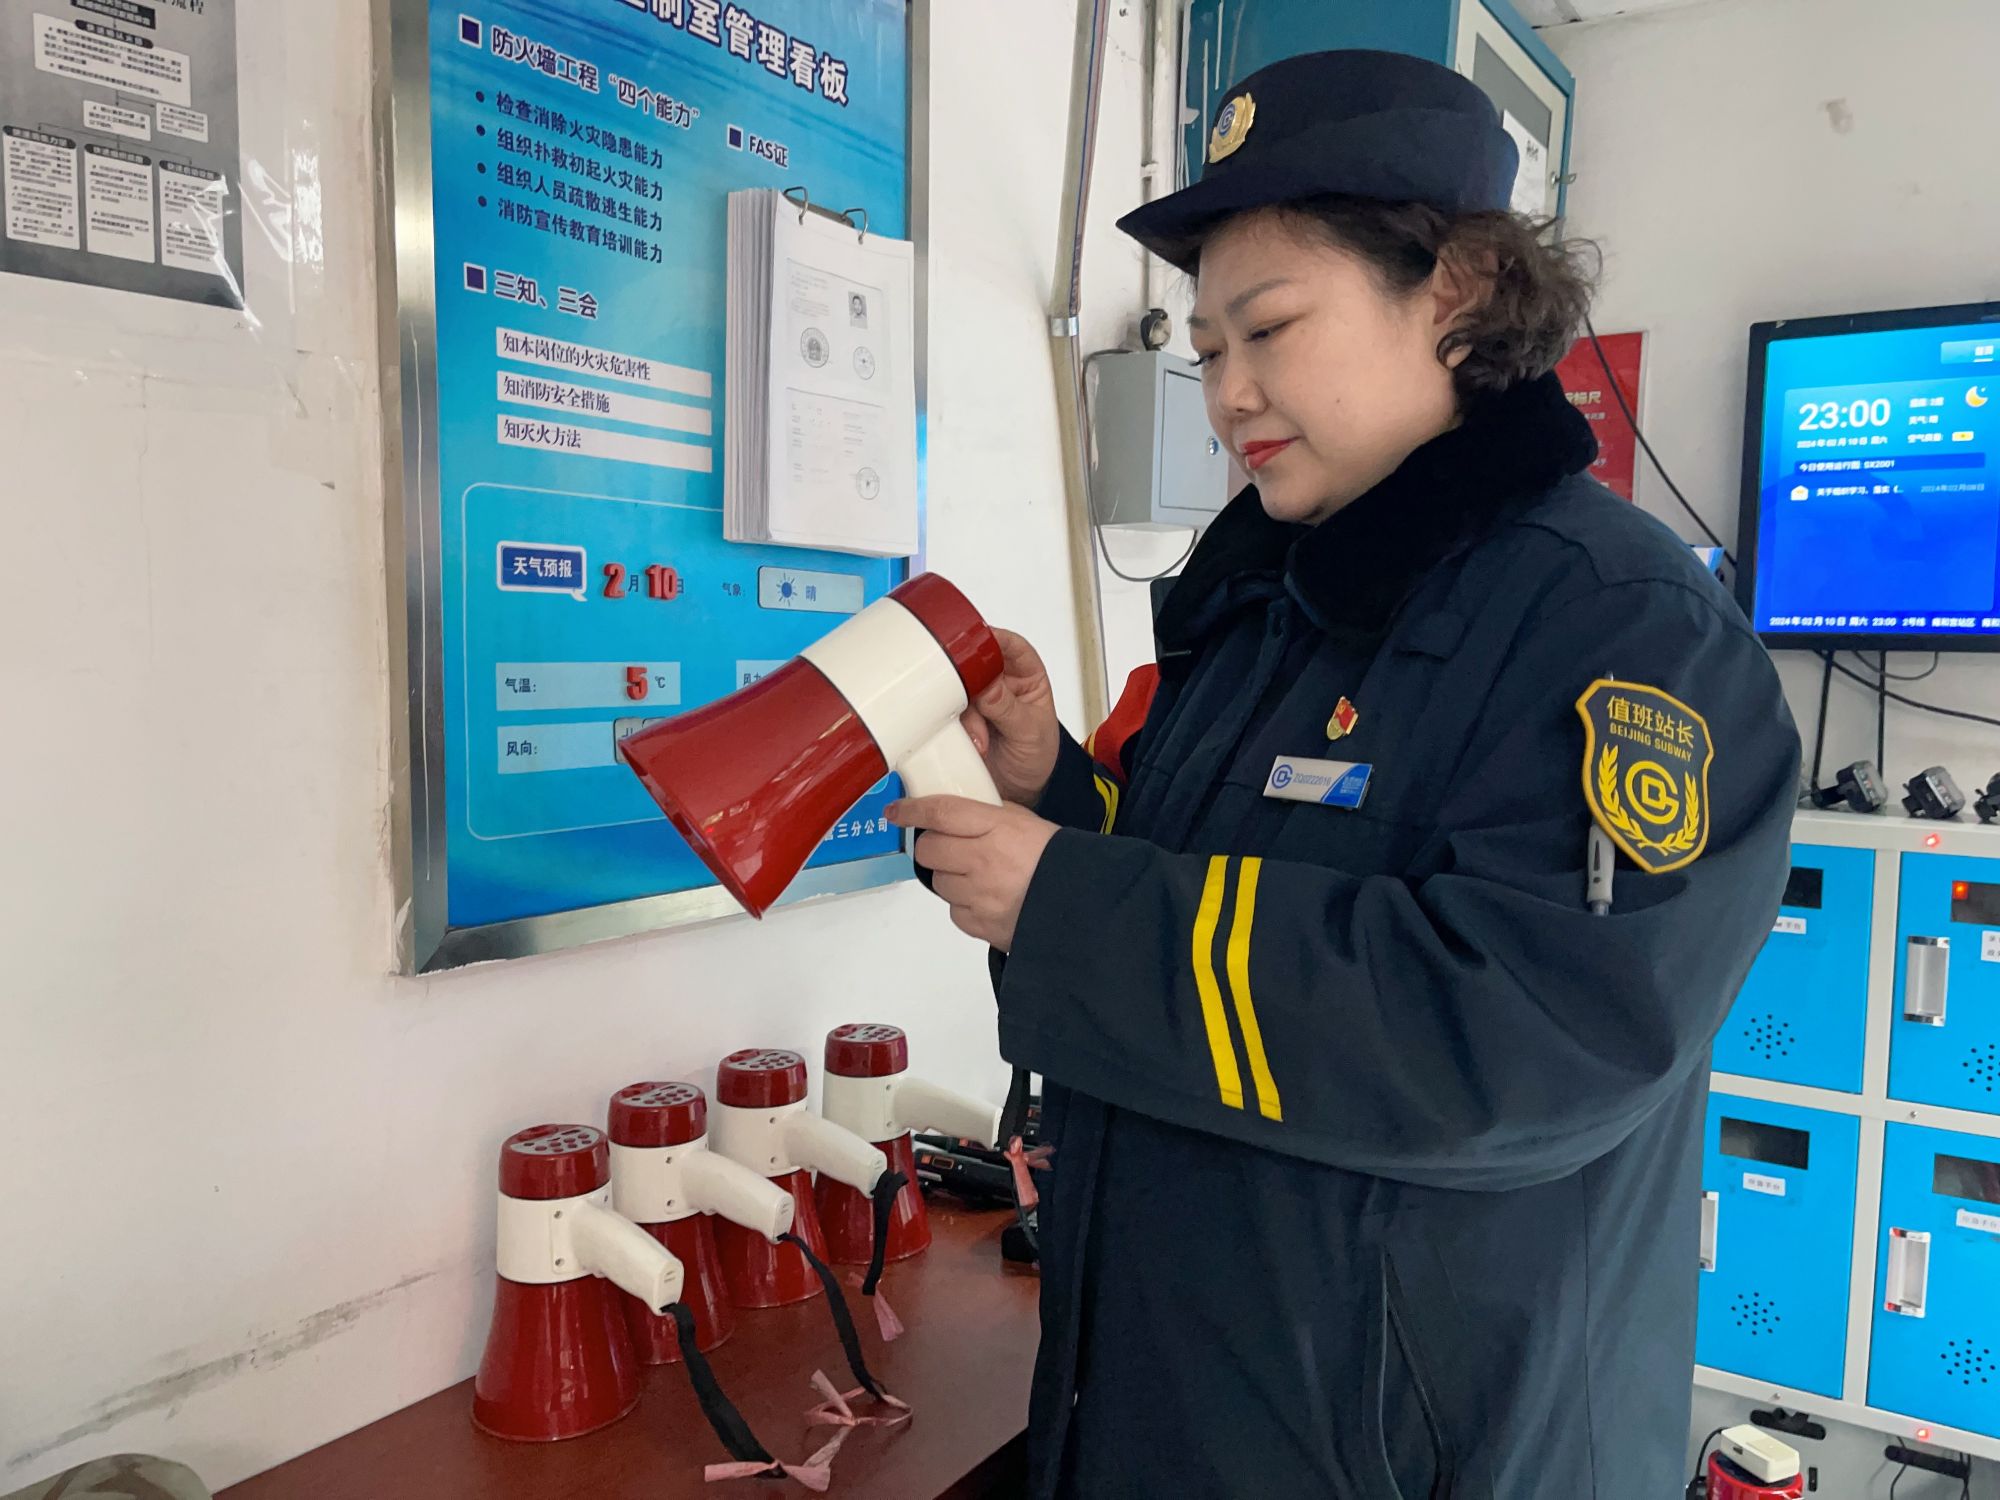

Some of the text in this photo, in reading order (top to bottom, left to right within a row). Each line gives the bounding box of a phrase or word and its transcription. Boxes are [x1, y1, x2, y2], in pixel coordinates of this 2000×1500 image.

[614, 0, 849, 106] 制室管理看板
[491, 26, 700, 128] 防火墙工程 “四个能力”
[496, 91, 663, 169] 检查消除火灾隐患能力
[497, 128, 663, 201] 组织扑救初起火灾能力
[749, 134, 788, 168] FAS证
[497, 162, 663, 232] 组织人员疏散逃生能力
[498, 198, 663, 263] 消防宣传教育培训能力
[495, 271, 598, 319] 三知、三会
[503, 332, 651, 381] 知本岗位的火灾危害性
[503, 376, 610, 413] 知消防安全措施
[1798, 397, 1891, 431] 23:00
[503, 419, 581, 448] 知灭火方法
[513, 556, 572, 579] 天气预报
[805, 584, 817, 601] 晴
[1872, 617, 1896, 627] 23:00
[505, 677, 537, 694] 气温:
[626, 666, 649, 700] 5
[1606, 695, 1694, 749] 值班站长
[1610, 722, 1692, 762] BEIJING SUBWAY
[506, 740, 538, 757] 风向:
